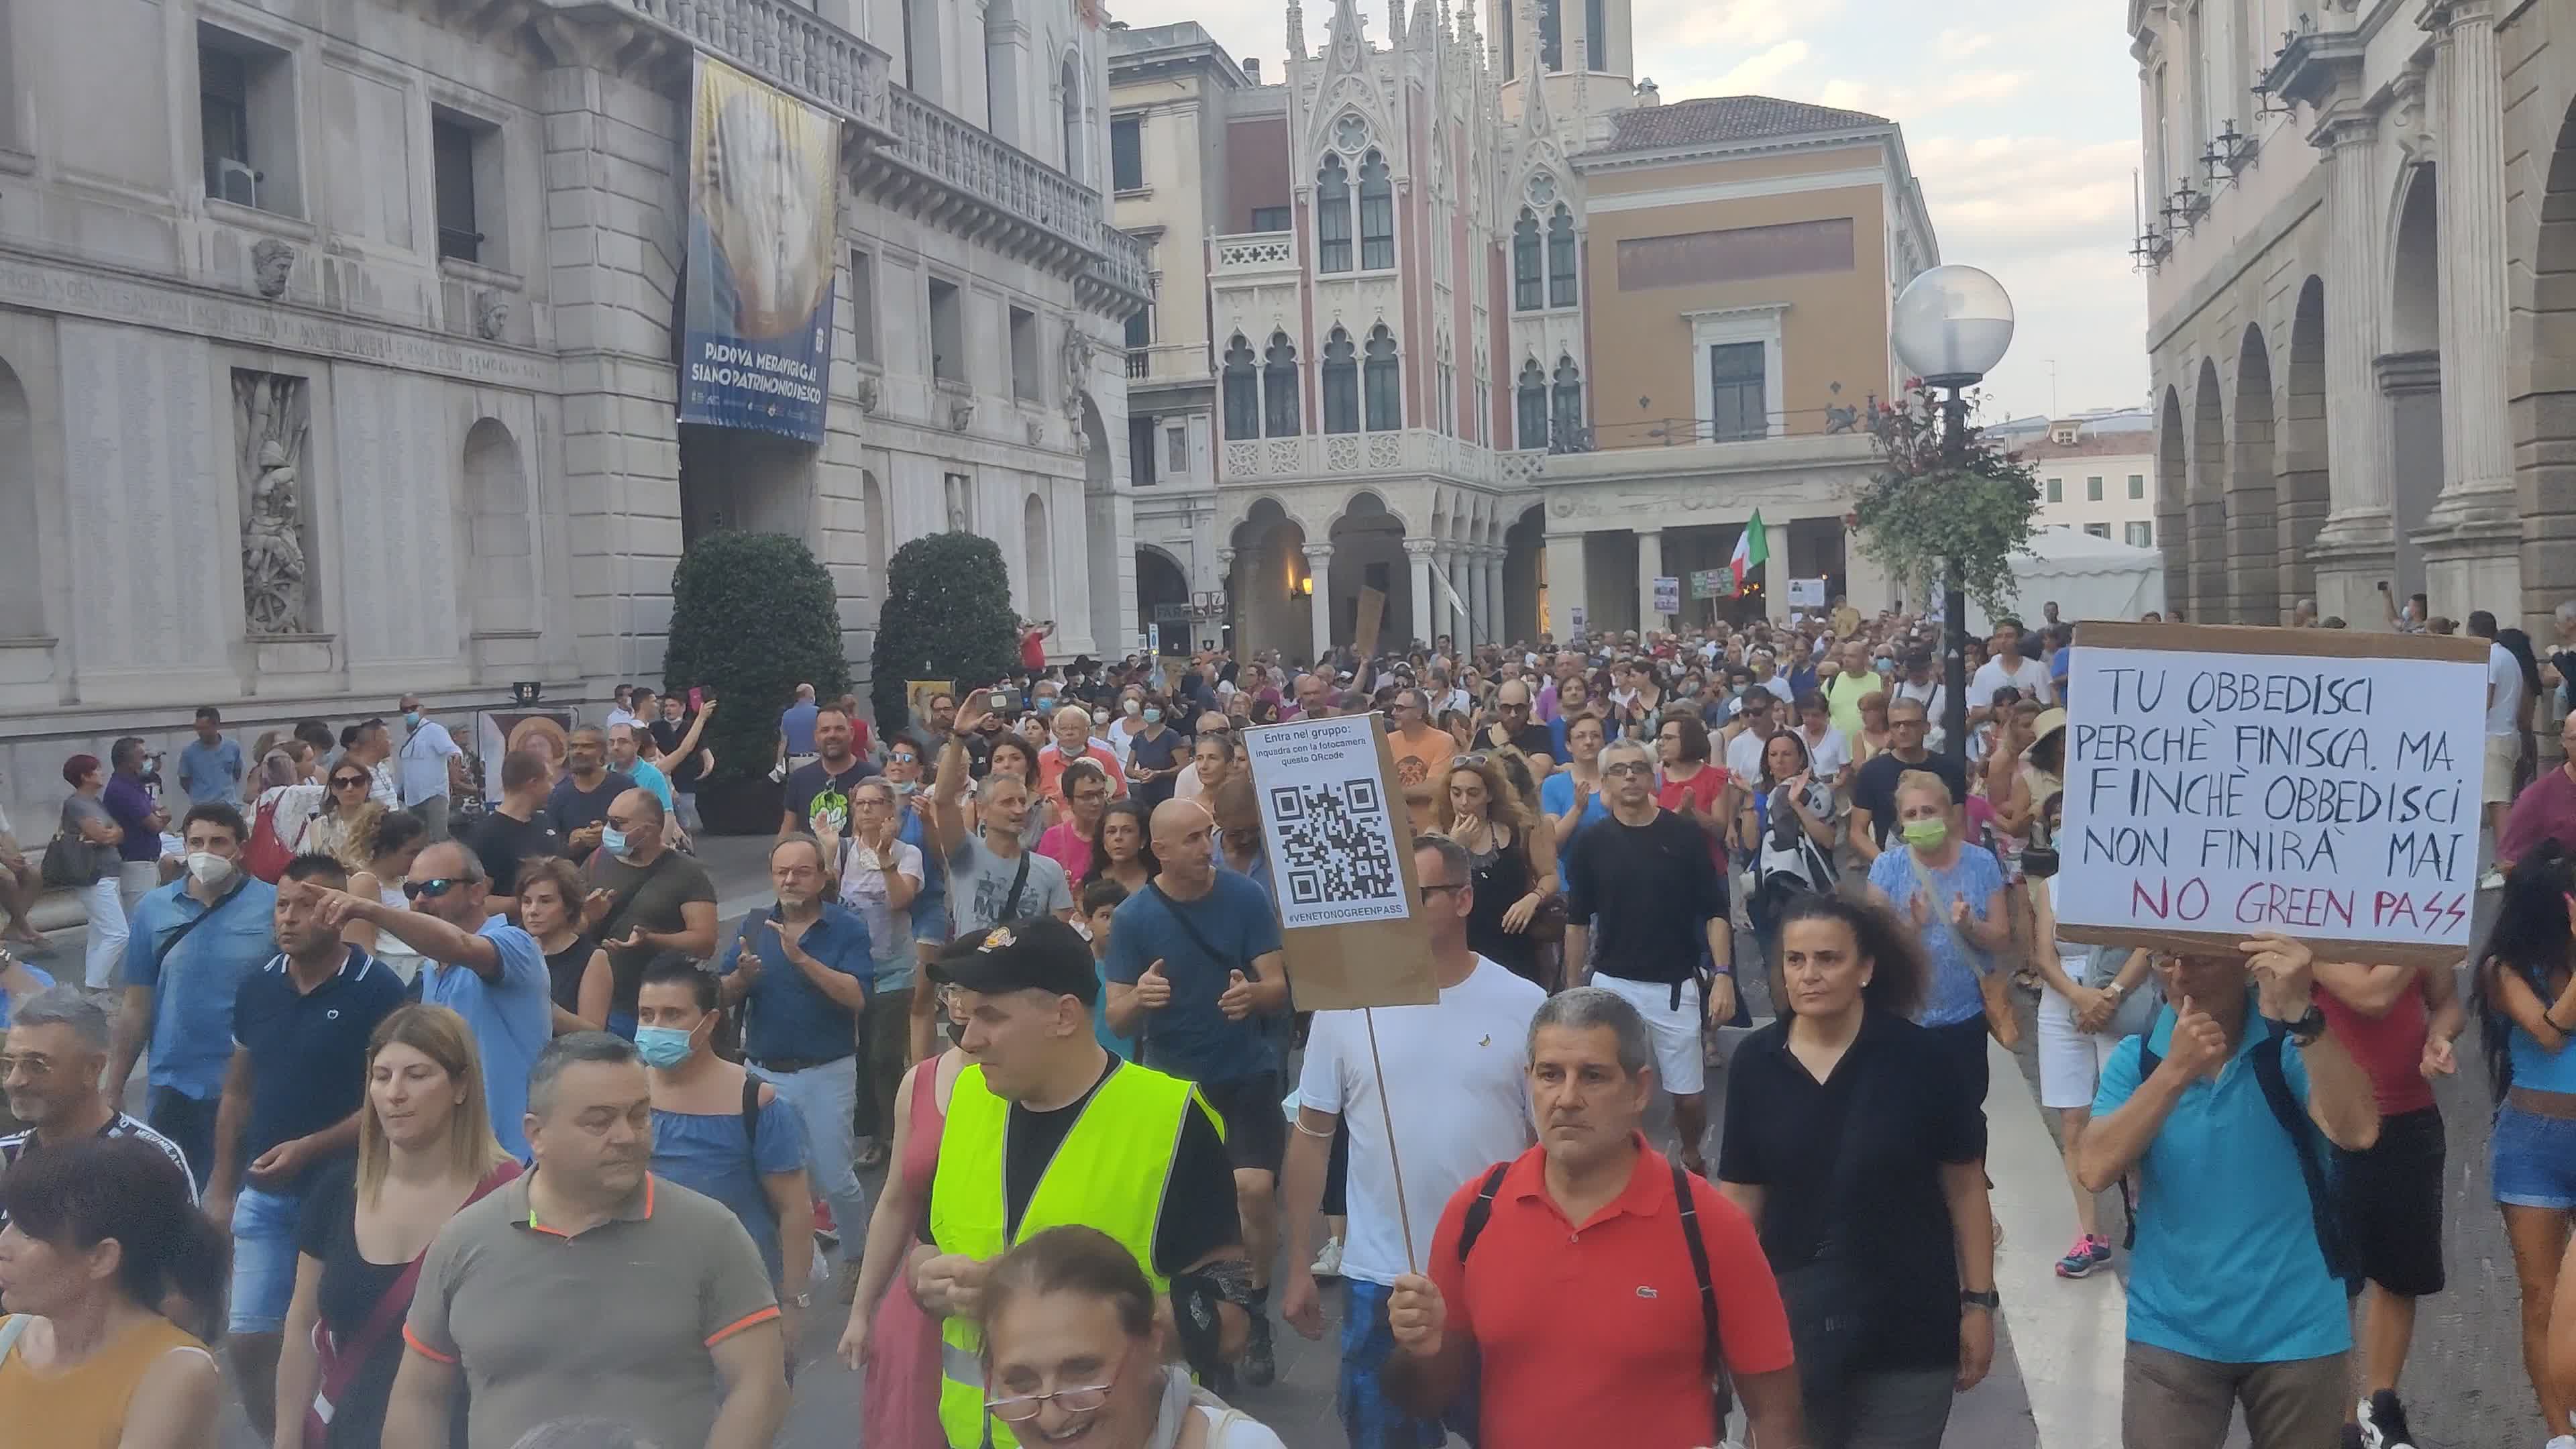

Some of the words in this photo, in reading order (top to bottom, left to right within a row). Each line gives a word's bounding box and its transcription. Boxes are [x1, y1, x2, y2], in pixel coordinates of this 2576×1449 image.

[706, 342, 753, 368] PADOVA
[2098, 668, 2166, 714] TU
[2187, 671, 2372, 715] OBBEDISCI
[1265, 733, 1291, 743] Entra
[1293, 729, 1309, 739] nel
[1311, 725, 1351, 738] gruppo:
[1293, 745, 1308, 753] con
[1310, 743, 1318, 751] la
[1319, 739, 1366, 749] fotocamera
[2076, 718, 2216, 765] PERCHÈ
[2234, 724, 2377, 771] FINISCA.
[2396, 731, 2454, 771] MA
[1281, 756, 1309, 767] questo
[1311, 751, 1344, 762] QRcode
[2090, 764, 2249, 816] FINCHÈ
[2084, 825, 2168, 867] NON
[2201, 826, 2345, 873] FINIRÀ
[2387, 832, 2463, 881] MAI
[1289, 904, 1403, 922] #VENETONOGREENPASS
[2131, 876, 2209, 920] NO
[2236, 881, 2354, 927] GREEN
[2373, 890, 2466, 934] PASS
